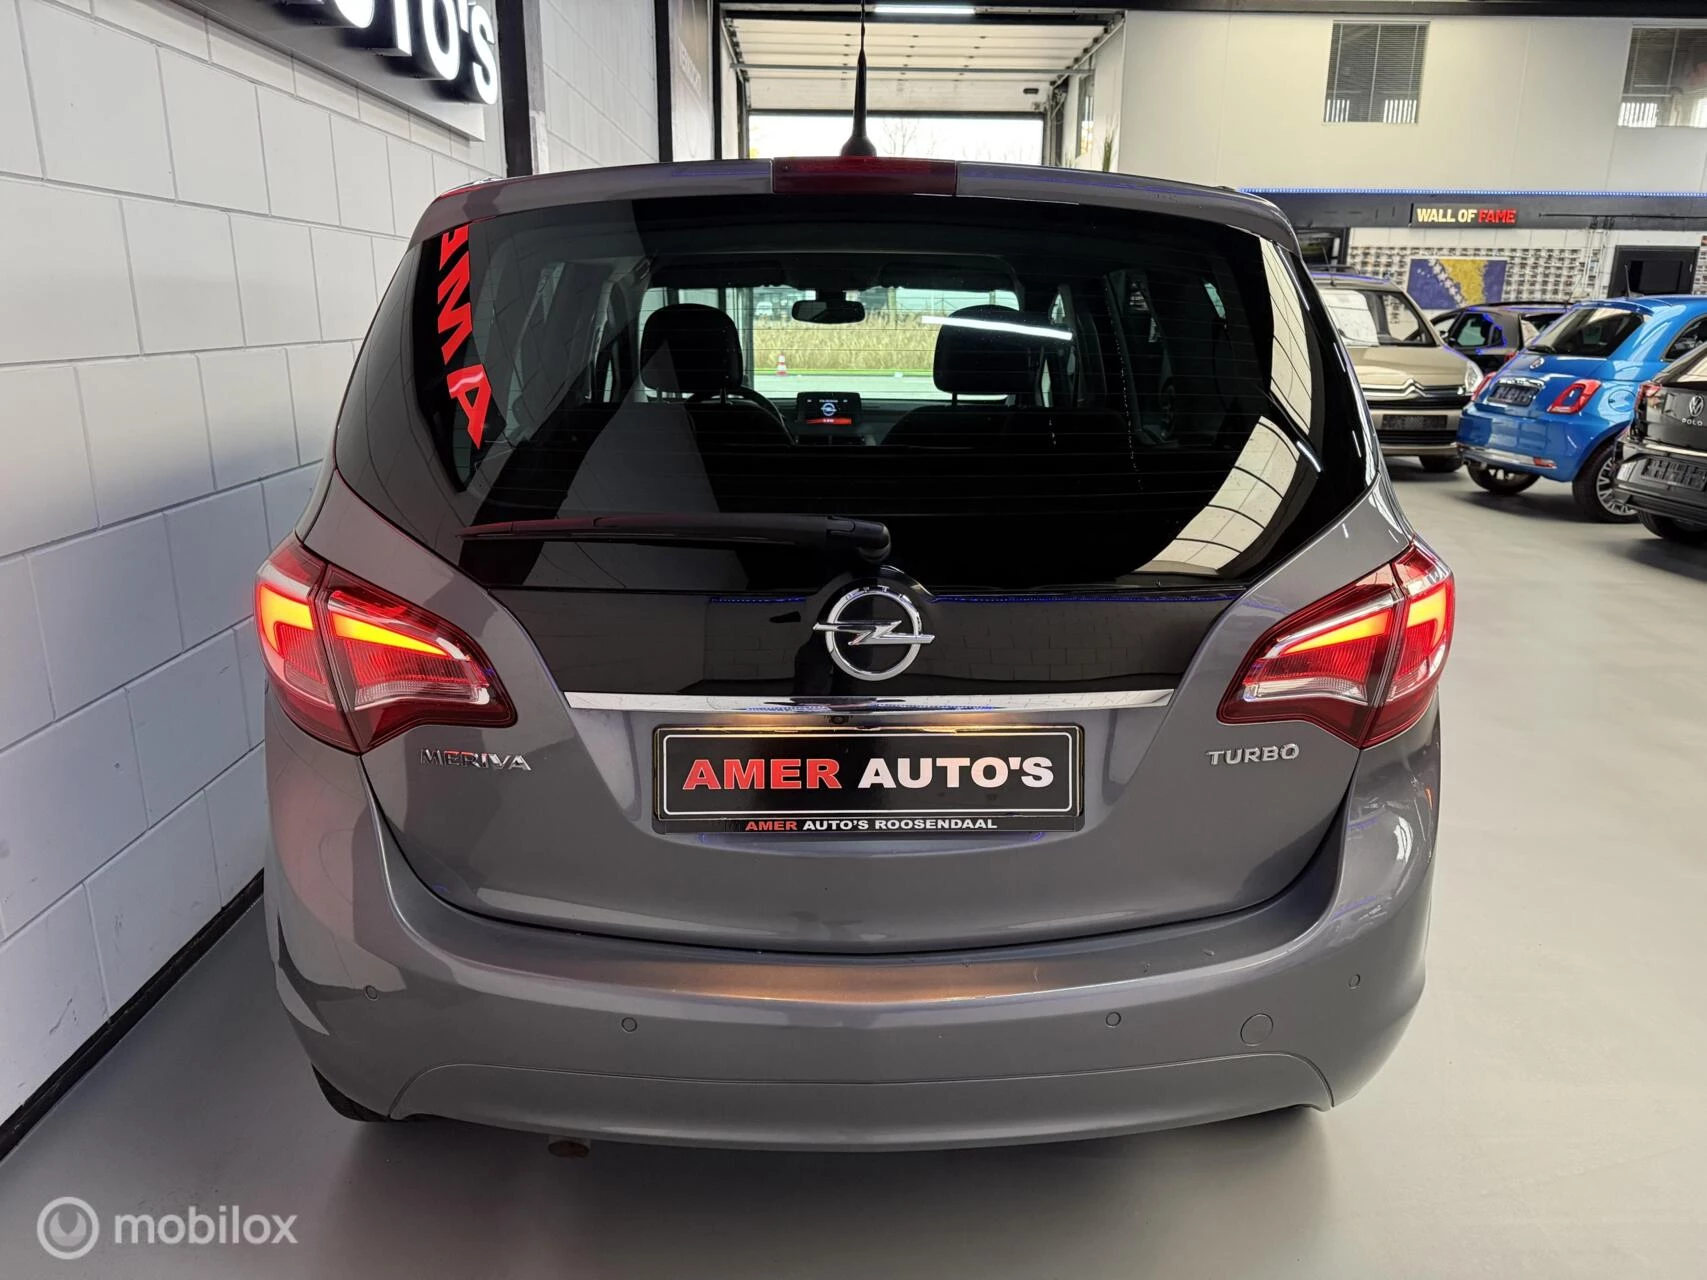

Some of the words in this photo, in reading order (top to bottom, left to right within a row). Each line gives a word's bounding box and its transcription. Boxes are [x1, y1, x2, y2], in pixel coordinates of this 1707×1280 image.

[1416, 208, 1456, 223] WALL
[1457, 208, 1478, 223] OF
[1478, 208, 1517, 223] FAME
[1681, 417, 1704, 427] POLO
[420, 748, 532, 772] MERIVA
[1207, 742, 1300, 766] TURBO
[682, 758, 842, 790] AMER
[857, 756, 1055, 789] AUTO'S
[745, 820, 798, 831] AMER
[802, 819, 870, 831] AUTO'S
[874, 818, 998, 830] ROOSENDAAL
